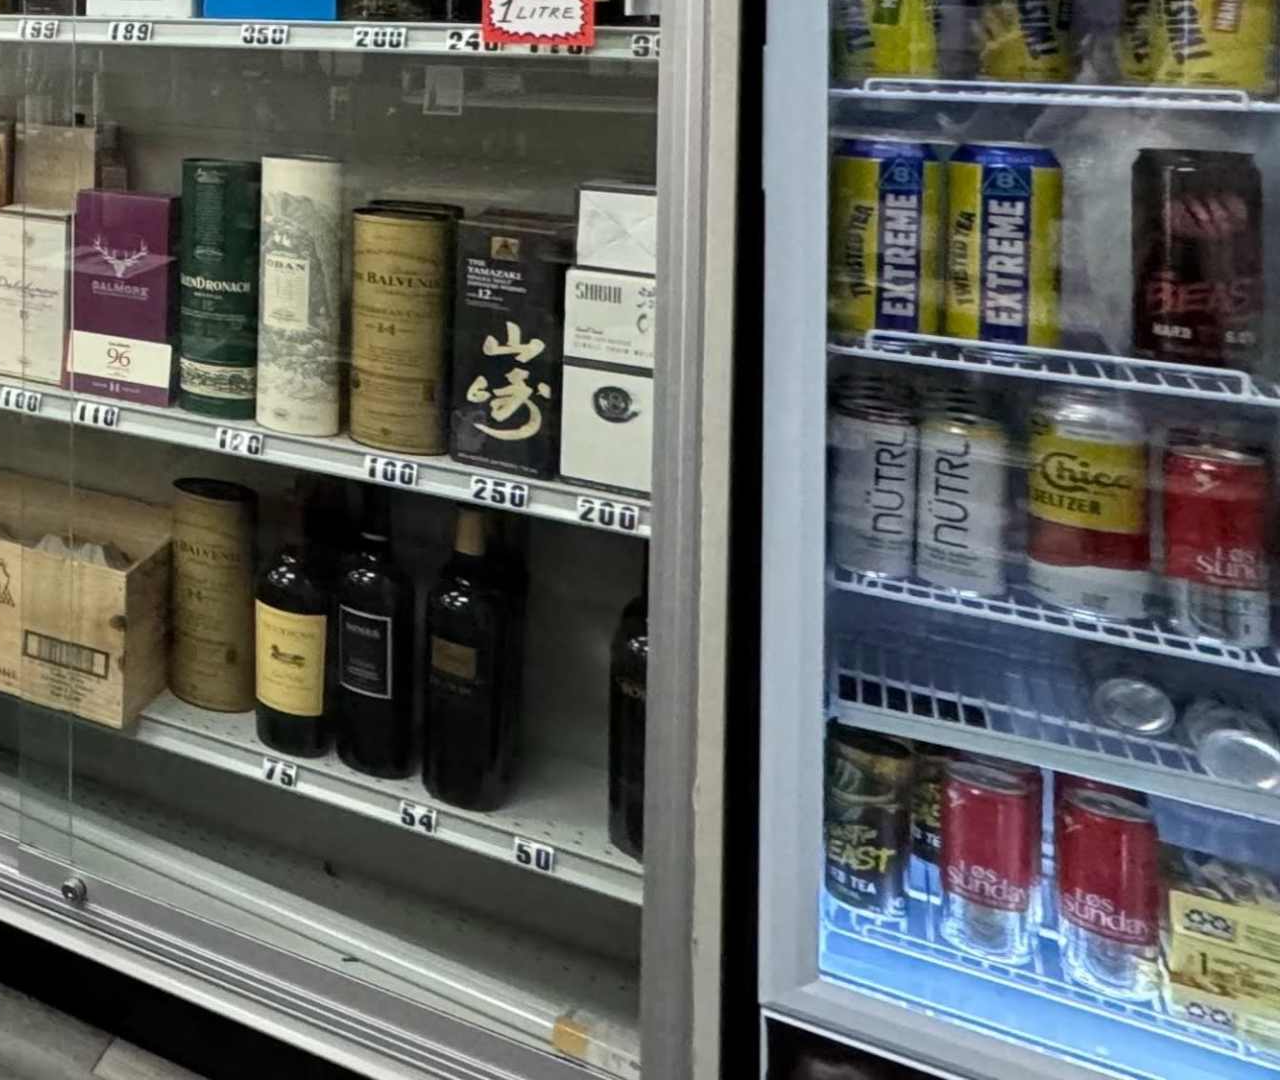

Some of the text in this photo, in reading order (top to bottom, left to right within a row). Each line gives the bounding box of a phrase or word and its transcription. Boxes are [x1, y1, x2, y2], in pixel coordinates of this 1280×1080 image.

[515, 6, 576, 20] LITRE
[110, 22, 149, 41] 189
[242, 26, 284, 45] 350
[356, 29, 402, 48] 200
[267, 258, 307, 271] OBAN
[881, 193, 918, 317] EXTREME
[985, 199, 1025, 327] EXTREME
[476, 288, 492, 300] 12
[106, 346, 131, 368] 96
[3, 390, 38, 411] 100
[79, 404, 116, 426] 110
[368, 457, 415, 486] 100
[471, 478, 526, 509] 250
[579, 498, 636, 531] 200
[265, 758, 295, 787] 75
[400, 800, 435, 832] 54
[516, 841, 551, 871] 50
[850, 875, 878, 895] TEA
